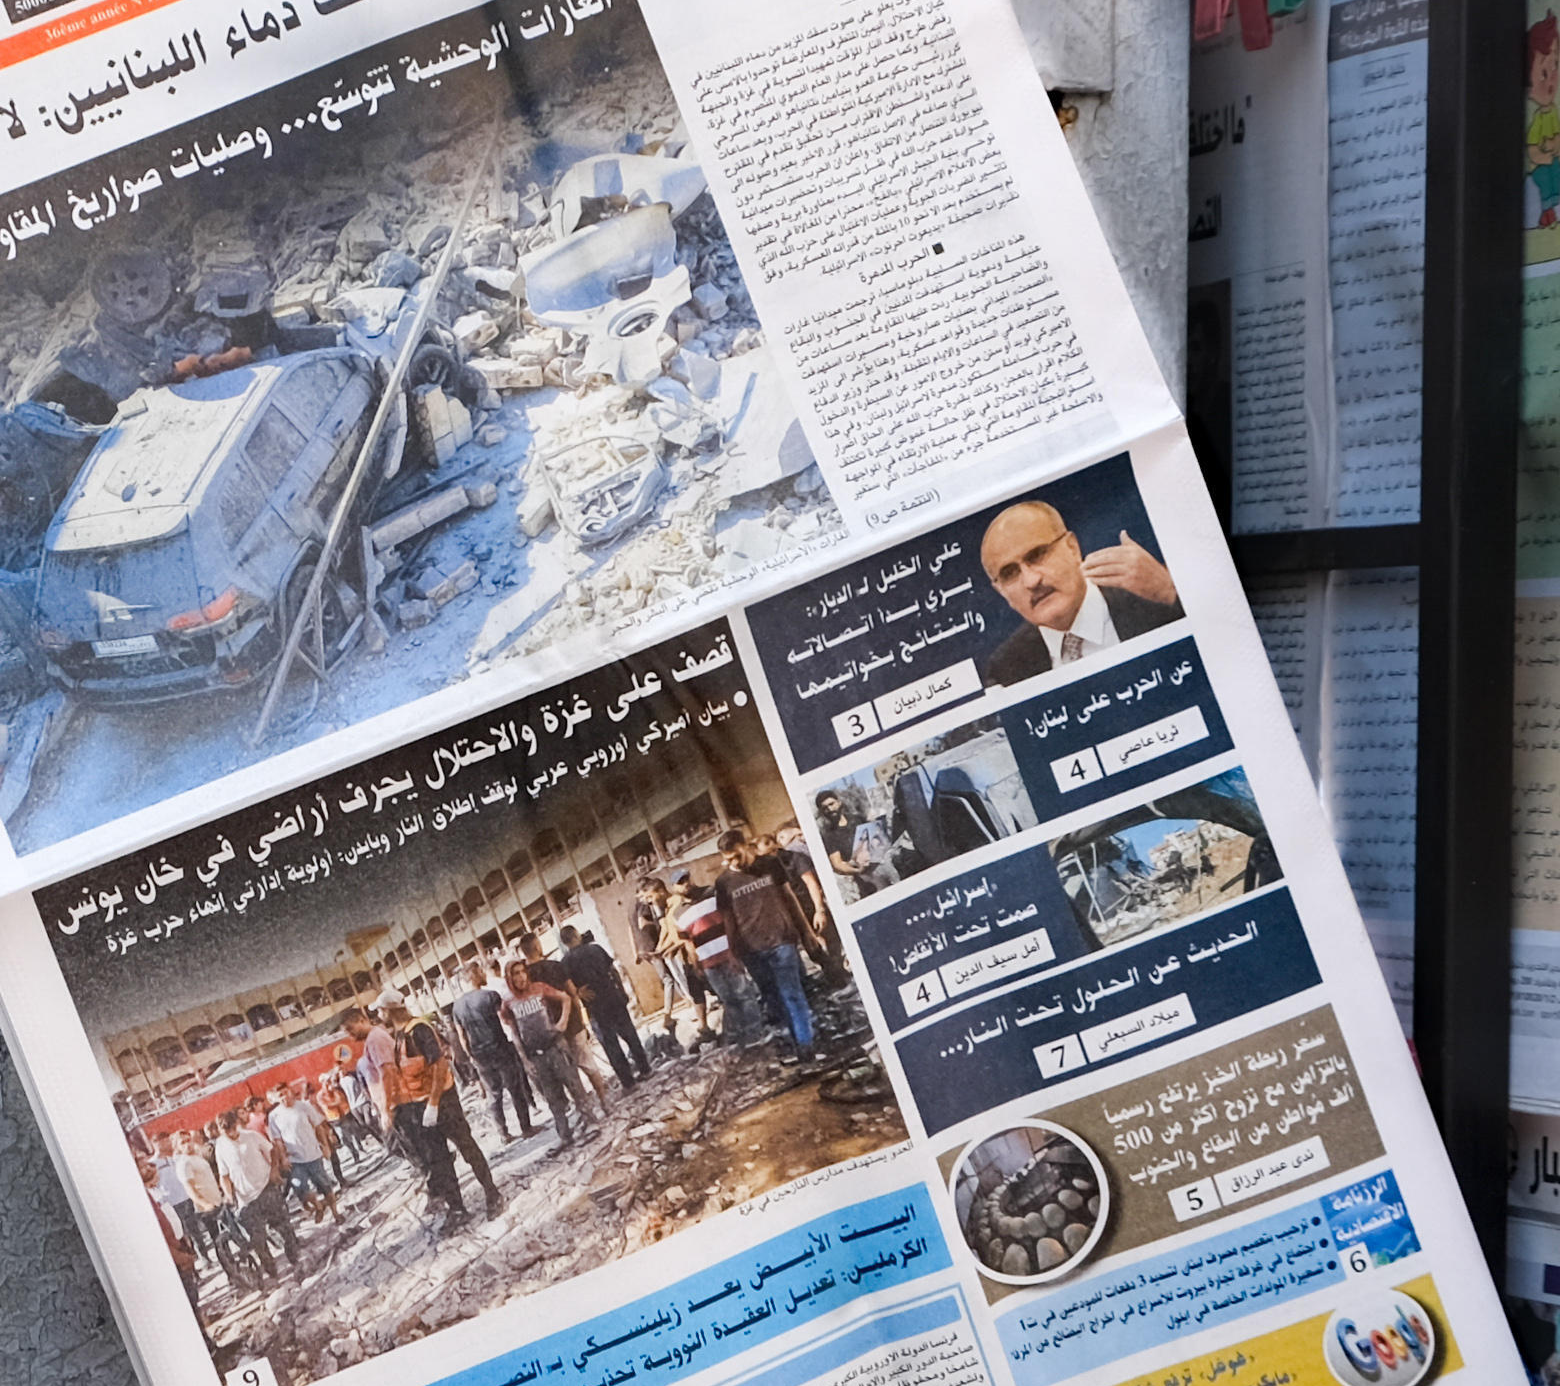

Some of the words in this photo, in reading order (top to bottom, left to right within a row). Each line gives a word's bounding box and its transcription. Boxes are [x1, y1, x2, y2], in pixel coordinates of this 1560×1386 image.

[225, 0, 302, 60] دماء
[398, 20, 510, 88] الوحشية
[37, 27, 207, 135] اللبنانيين:
[169, 126, 273, 179] وصليات
[66, 167, 163, 231] صواريخ
[670, 633, 734, 683] قصف
[786, 613, 875, 664] اتصالاته
[898, 610, 985, 664] والنتائج
[1115, 668, 1163, 701] الحرب
[1169, 660, 1193, 686] عن
[539, 693, 592, 739] غزة
[606, 671, 662, 722] على
[1076, 693, 1111, 724] على
[847, 713, 865, 737] 3
[1024, 704, 1069, 739] لبنان!
[424, 719, 538, 790] والاحتلال
[1069, 758, 1086, 780] 4
[338, 769, 419, 814] يجرف
[247, 792, 329, 868] أراضي
[134, 856, 184, 905] خان
[195, 833, 236, 889] في
[57, 884, 129, 935] يونس
[952, 915, 991, 943] تحت
[995, 903, 1038, 928] صمت
[1186, 919, 1259, 963] الحديث
[1071, 966, 1140, 1014] الحلول
[1147, 954, 1181, 985] عن
[915, 981, 931, 1003] 4
[1014, 994, 1065, 1027] تحت
[1050, 1044, 1065, 1068] 7
[1113, 1125, 1154, 1155] 500
[1185, 1187, 1204, 1211] 5
[1349, 1249, 1367, 1273] 6
[784, 1268, 837, 1315] تعديل
[710, 1296, 777, 1340] العقيدة
[639, 1328, 707, 1371] النووية
